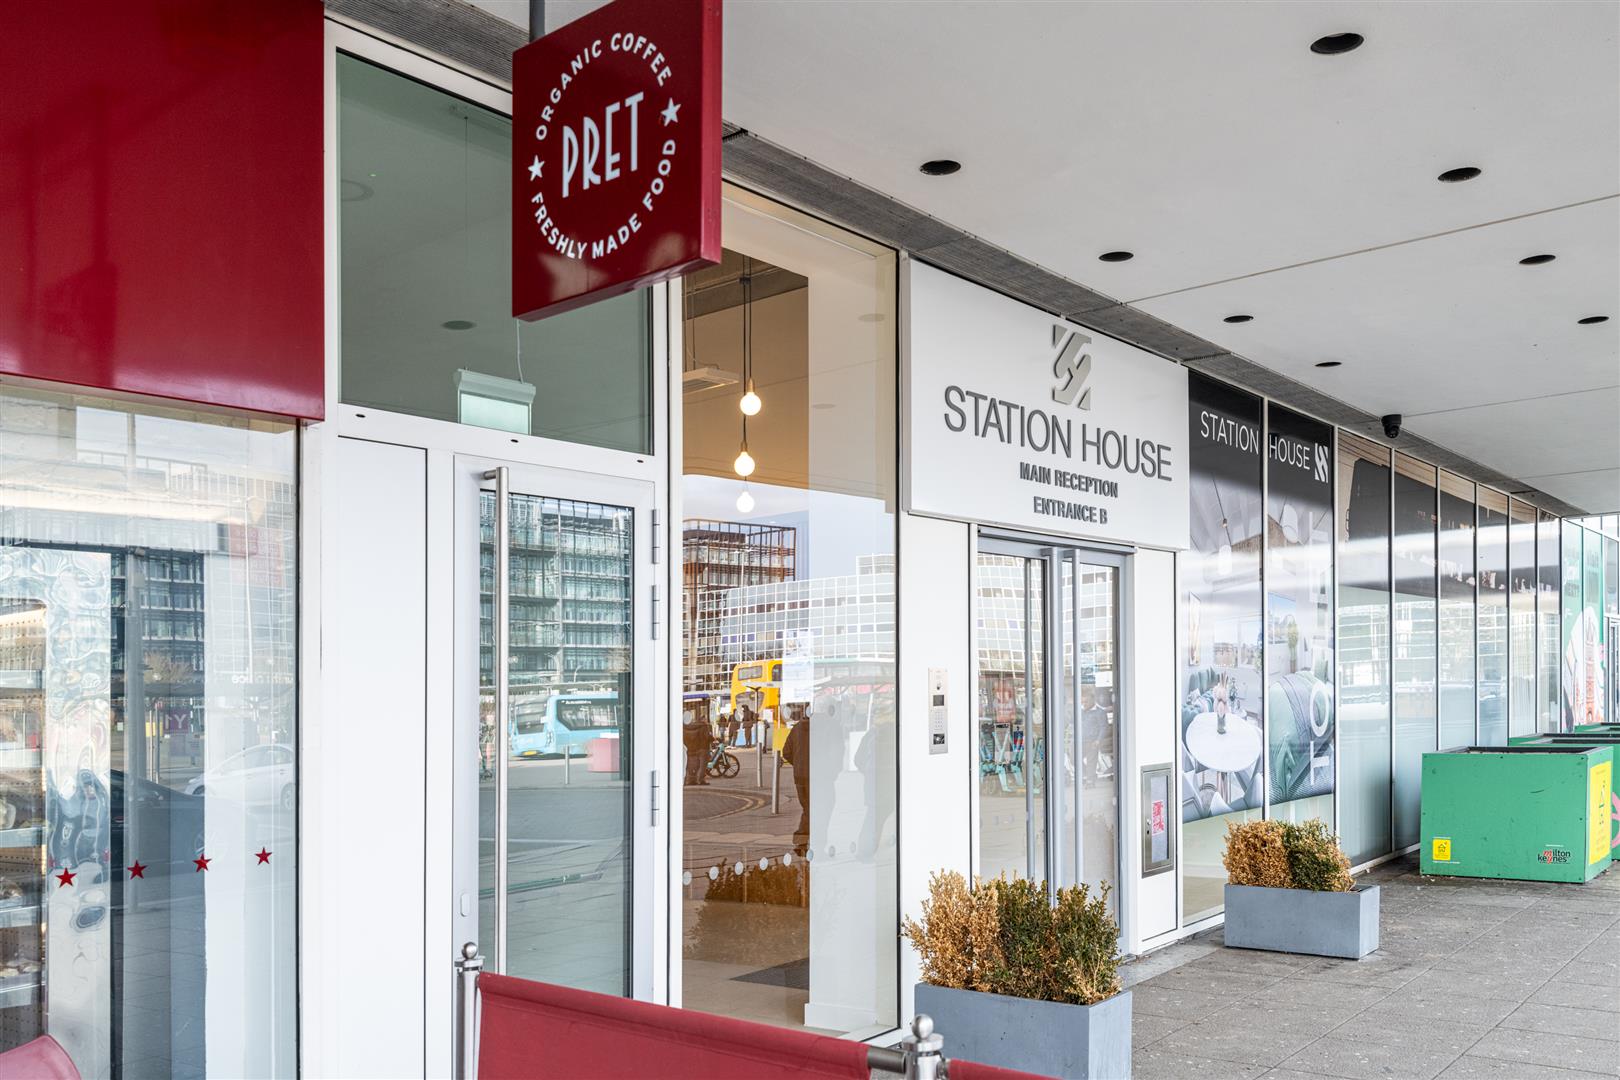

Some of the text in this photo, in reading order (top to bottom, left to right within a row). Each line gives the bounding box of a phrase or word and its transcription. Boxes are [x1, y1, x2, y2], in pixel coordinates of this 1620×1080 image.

[536, 32, 672, 141] ORGANIC COFFEE
[562, 91, 644, 198] PRET
[531, 139, 676, 260] FRESHLY MADE FOOD
[944, 385, 1172, 481] STATION HOUSE
[1020, 462, 1118, 498] MAIN RECEPTION
[1201, 411, 1310, 470] STATION HOUSE
[1033, 496, 1107, 524] ENTRANCE B
